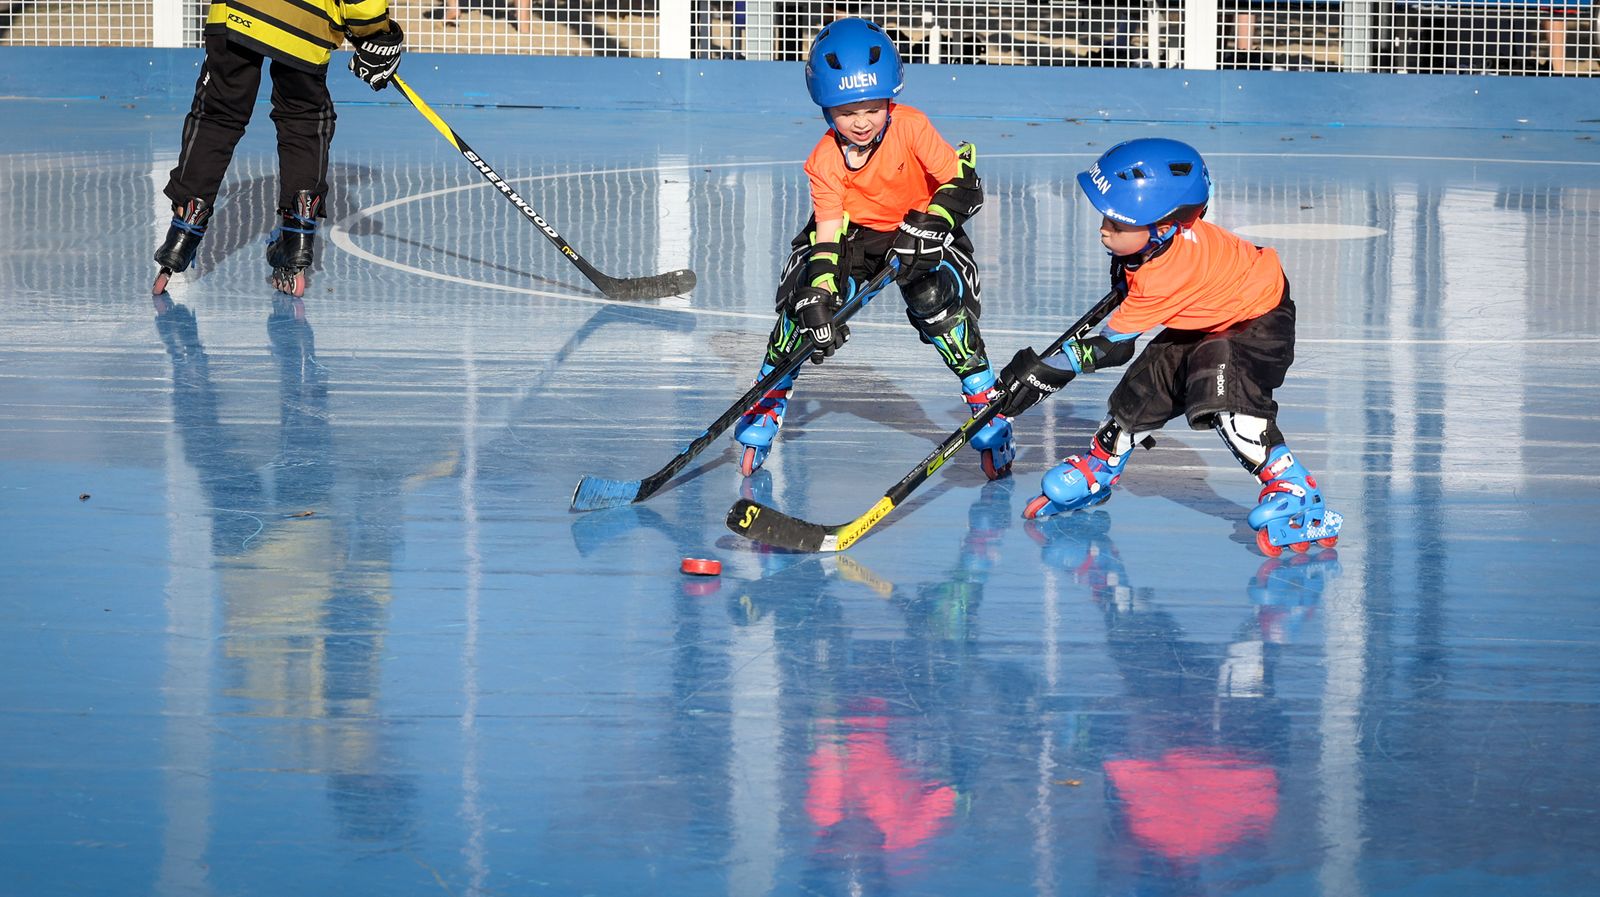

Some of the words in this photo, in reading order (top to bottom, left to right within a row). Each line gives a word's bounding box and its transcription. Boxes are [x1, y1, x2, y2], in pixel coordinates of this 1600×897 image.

[838, 72, 878, 91] JULEN
[463, 150, 559, 238] SHER-WOOD
[1089, 162, 1112, 195] DYLAN
[1216, 363, 1226, 397] Reebok
